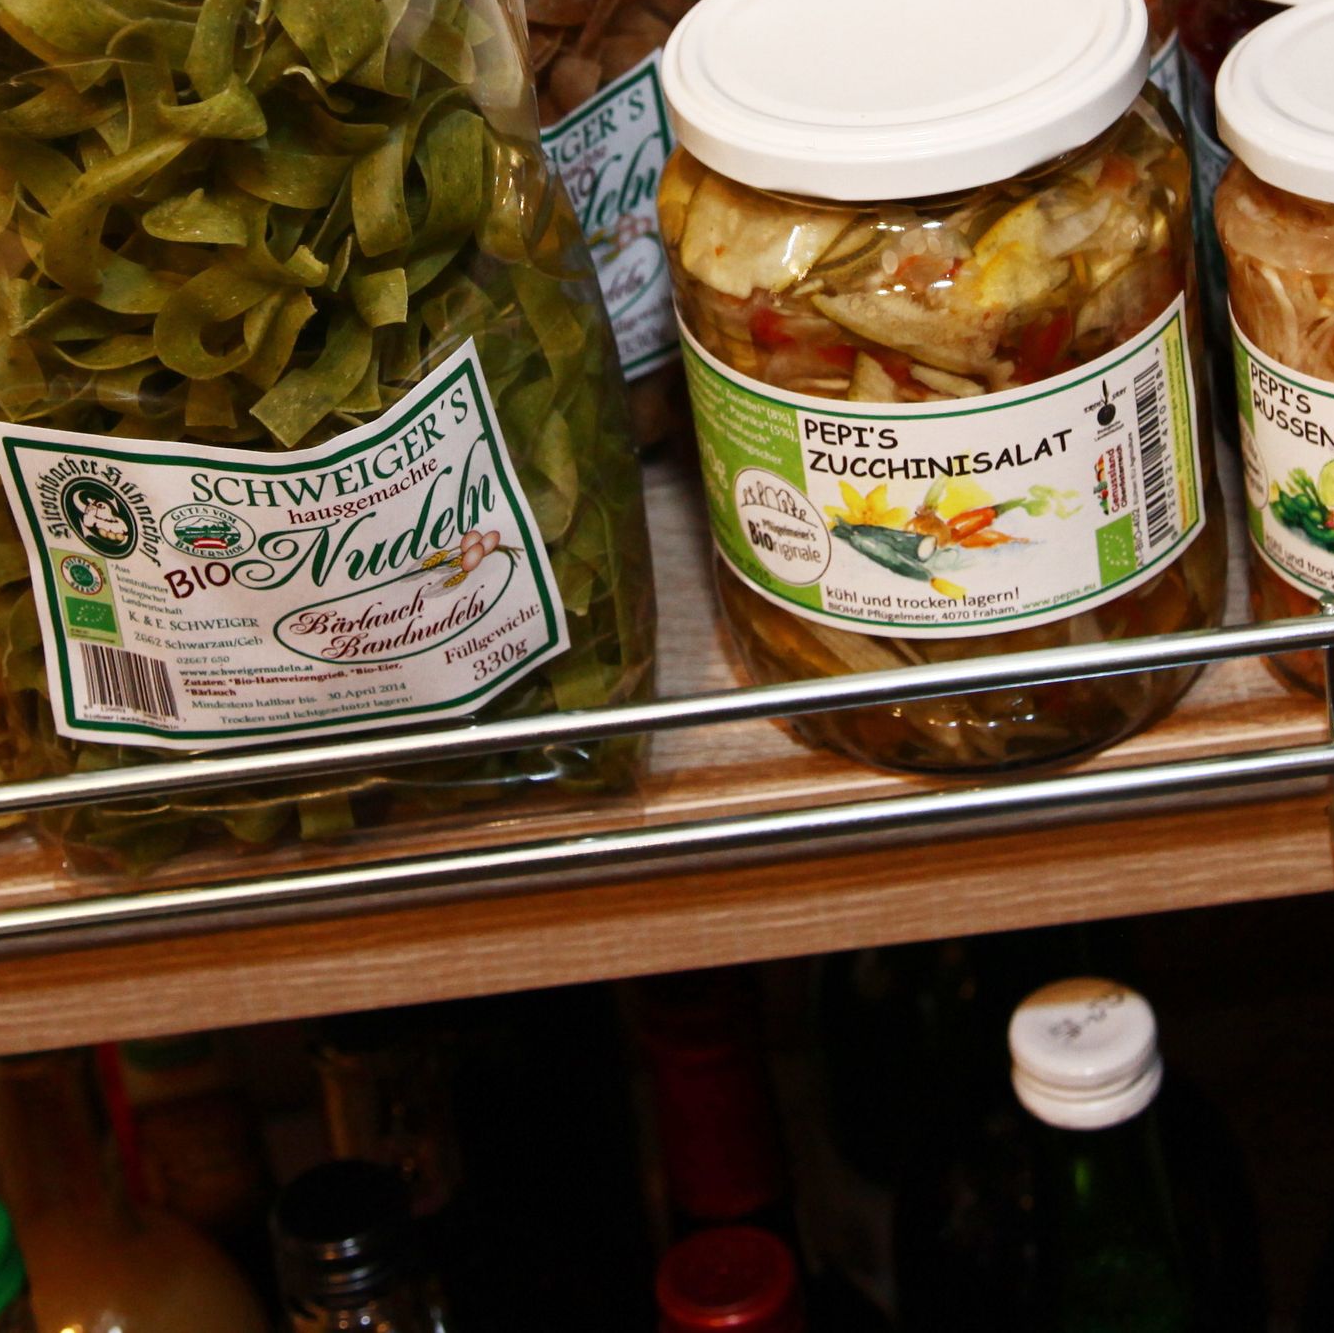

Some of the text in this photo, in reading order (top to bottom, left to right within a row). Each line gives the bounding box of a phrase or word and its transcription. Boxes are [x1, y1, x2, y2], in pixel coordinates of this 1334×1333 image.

[1250, 362, 1312, 415] PEPI'S
[804, 418, 899, 450] PEPI'S
[807, 429, 1074, 480] ZUCCHINISALAT
[288, 458, 438, 524] hausgemachte
[1105, 447, 1122, 514] Genussland
[171, 506, 238, 525] GUTES VOM
[232, 432, 496, 590] Nudeln
[175, 542, 245, 559] BAUERNHOF
[1285, 549, 1305, 569] und
[164, 561, 231, 599] BIO
[289, 583, 432, 636] Bärlauch
[826, 585, 1020, 610] kühl und trocken lagern!
[867, 603, 1018, 624] Pflügelmeier, 4070 Fraham,
[128, 610, 259, 631] K. & E. SCHWEIGER
[321, 585, 486, 660] Bandnudeln
[443, 603, 541, 664] Füllgewicht:
[179, 663, 314, 678] www.schweigernudeln.at
[473, 636, 529, 682] 330g
[183, 677, 227, 688] Zutaten:
[191, 681, 408, 710] Mindestens haltbar April 2014
[220, 712, 292, 726] Trocken und
